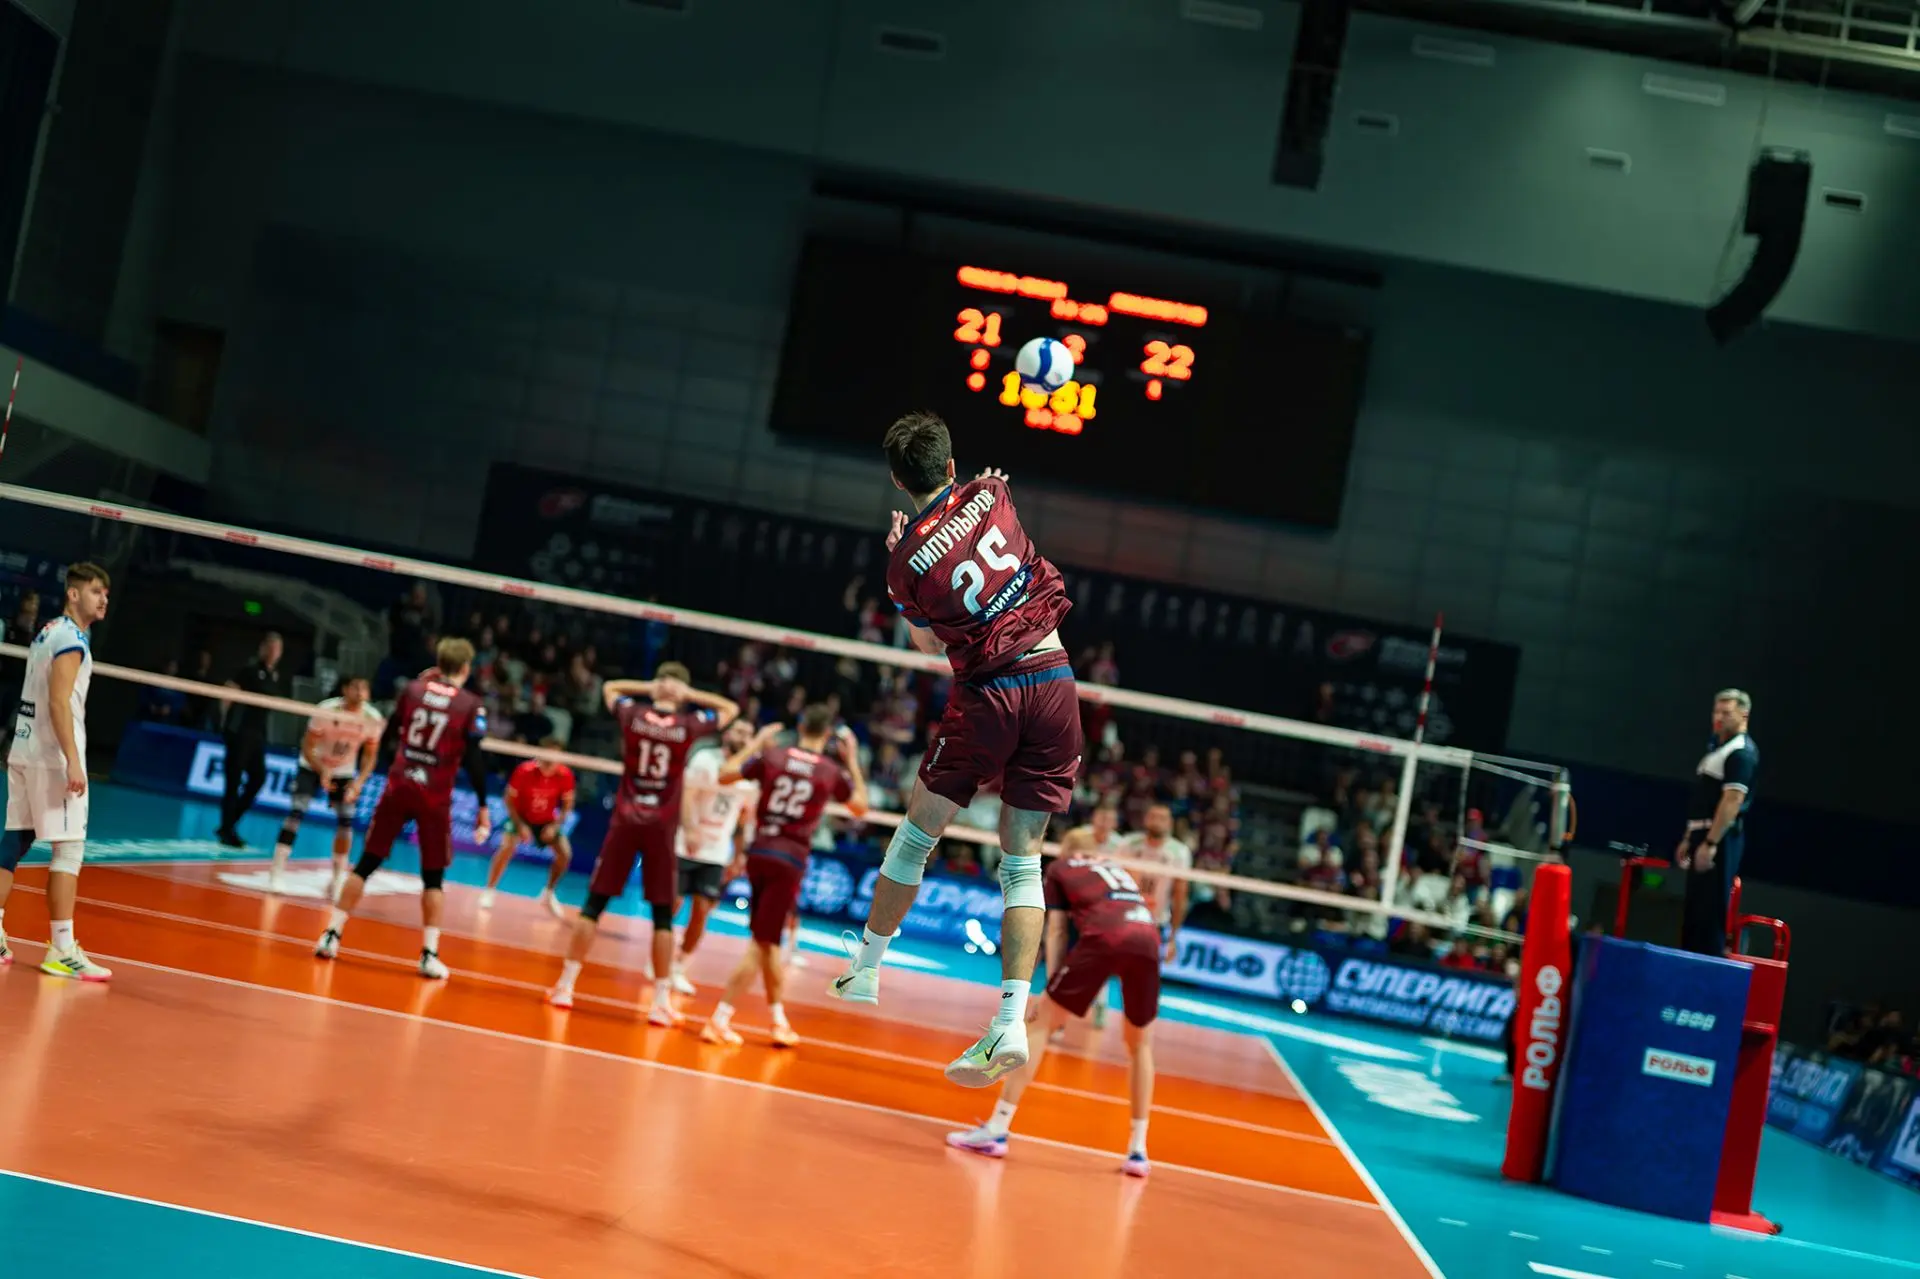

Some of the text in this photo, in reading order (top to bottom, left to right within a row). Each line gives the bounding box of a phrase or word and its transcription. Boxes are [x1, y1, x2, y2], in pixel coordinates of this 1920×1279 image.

[954, 308, 1001, 347] 21
[1140, 340, 1196, 381] 22
[951, 524, 1022, 616] 25
[407, 707, 449, 751] 27
[637, 738, 671, 778] 13
[767, 775, 814, 818] 22
[1174, 936, 1265, 979] ЛЬФ
[1335, 957, 1517, 1020] СУПЕРЛИГА
[1522, 965, 1563, 1091] РОЛЬФ
[1649, 1055, 1710, 1077] РОЛЬФ
